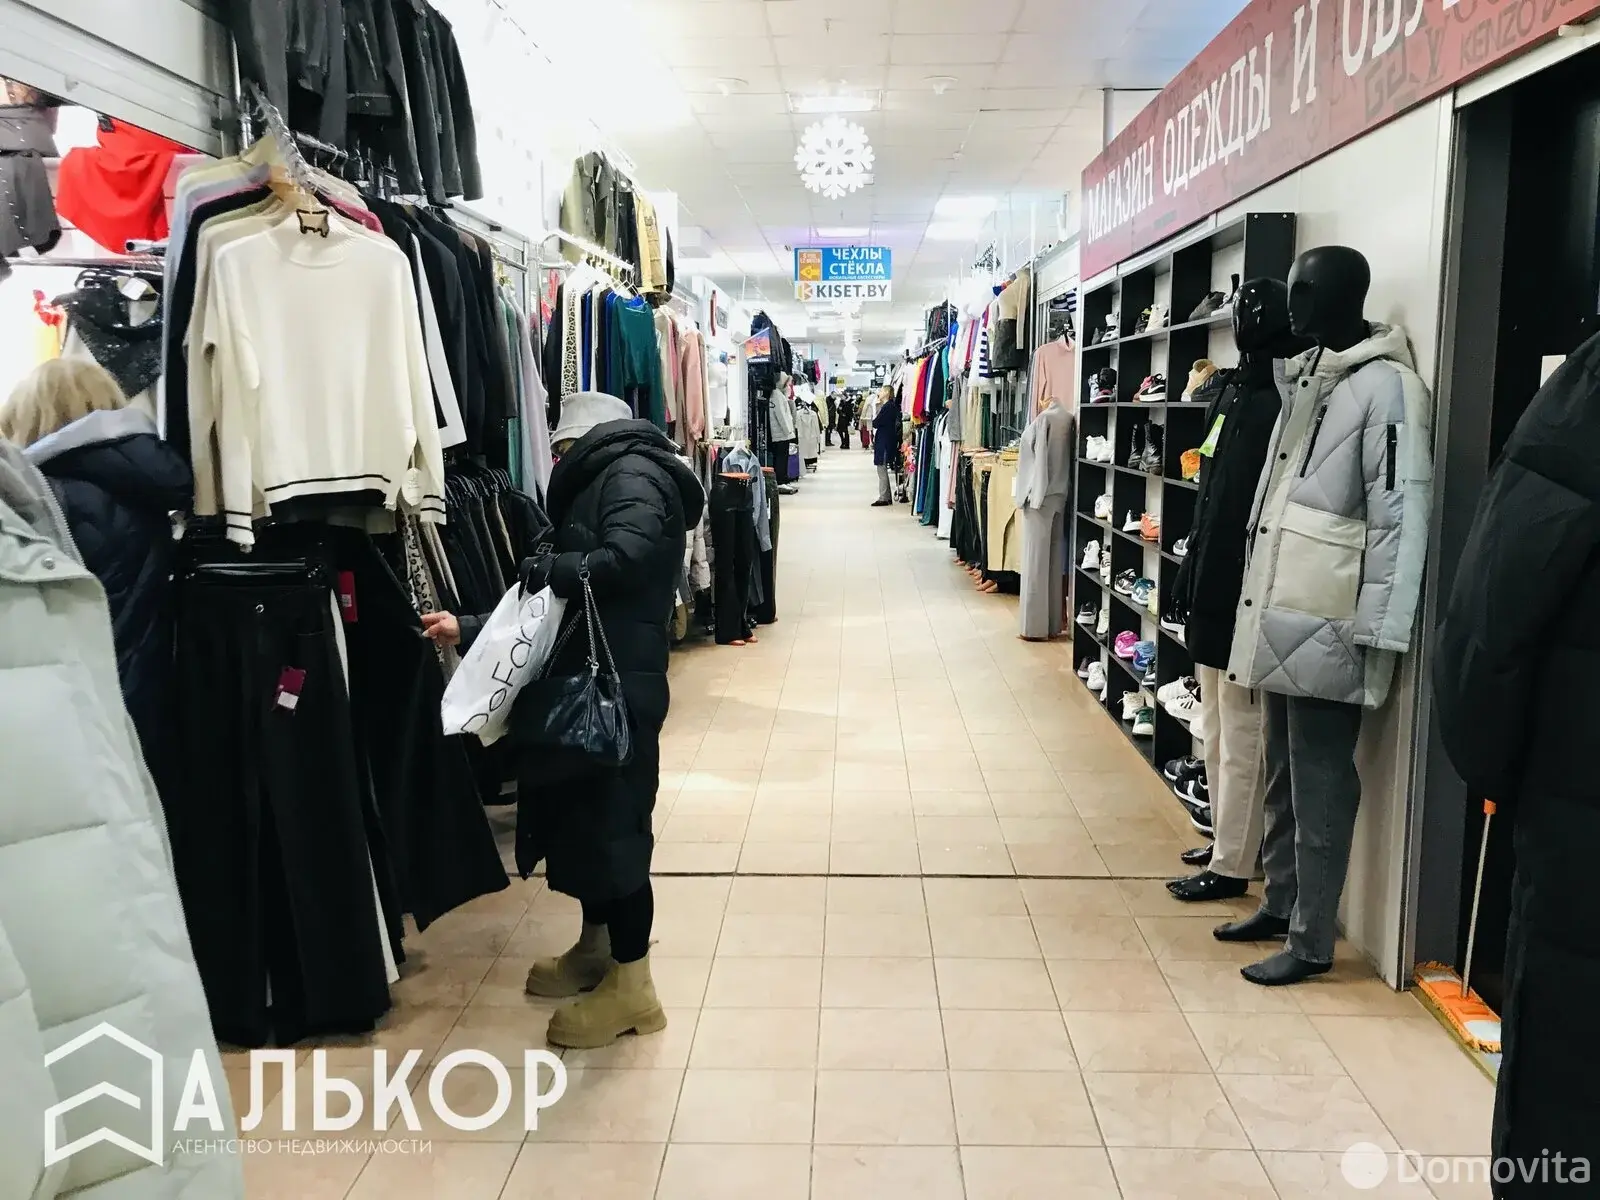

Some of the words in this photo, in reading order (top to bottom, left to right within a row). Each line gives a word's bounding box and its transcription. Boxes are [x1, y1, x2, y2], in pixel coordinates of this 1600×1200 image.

[1460, 0, 1536, 71] KENZO
[1087, 136, 1155, 244] МАГАЗИН
[1162, 32, 1274, 197] ОДЕЖДЫ
[1290, 0, 1320, 114] И
[832, 248, 882, 260] ЧЕХЛЫ
[829, 261, 885, 275] СТЁКЛА
[816, 284, 888, 298] KISET.BY
